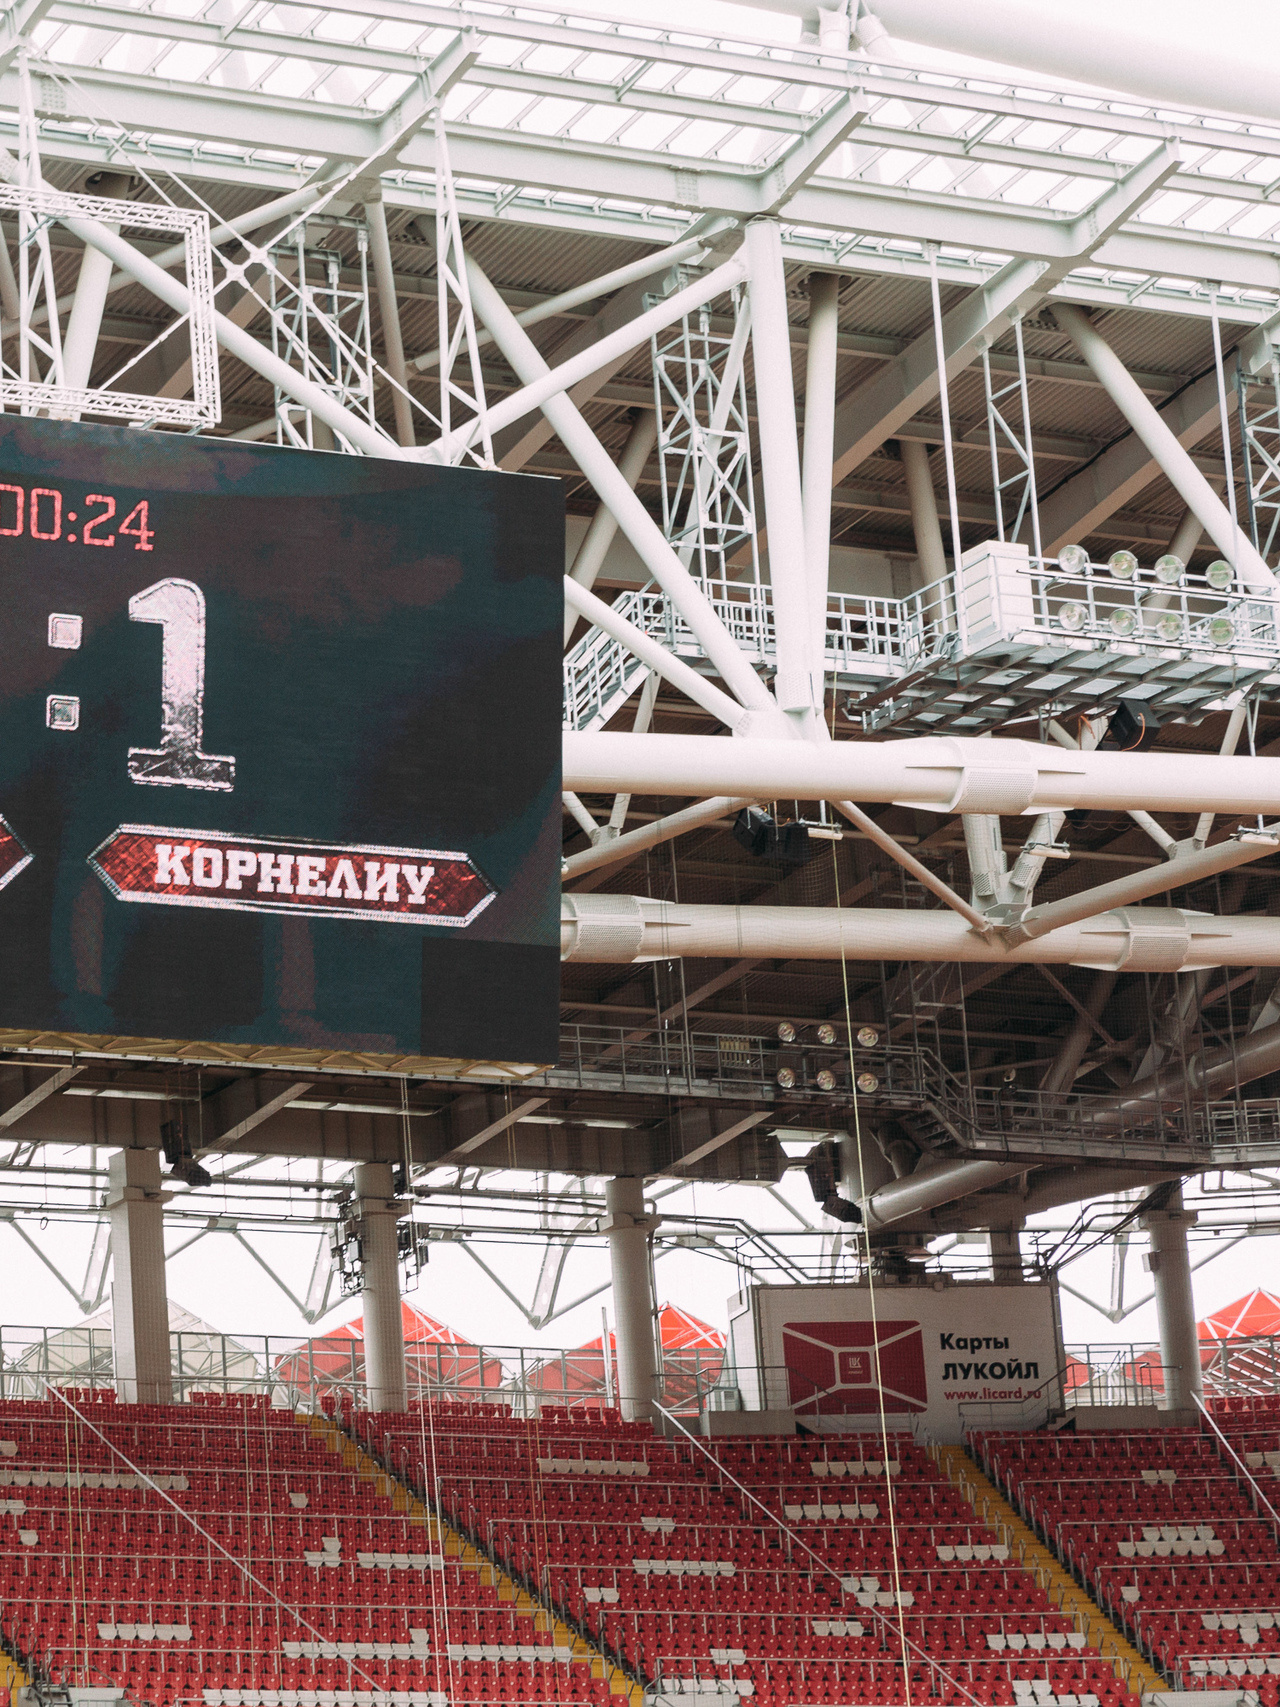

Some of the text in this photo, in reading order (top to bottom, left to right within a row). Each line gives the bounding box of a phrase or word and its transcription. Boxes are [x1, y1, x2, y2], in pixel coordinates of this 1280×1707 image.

[128, 577, 236, 792] 1
[155, 844, 435, 905] КОРНЕЛИУ
[940, 1333, 1009, 1354] Карты
[942, 1358, 1039, 1380] ЛУКОЙЛ
[944, 1387, 1042, 1400] www.licard.ru
